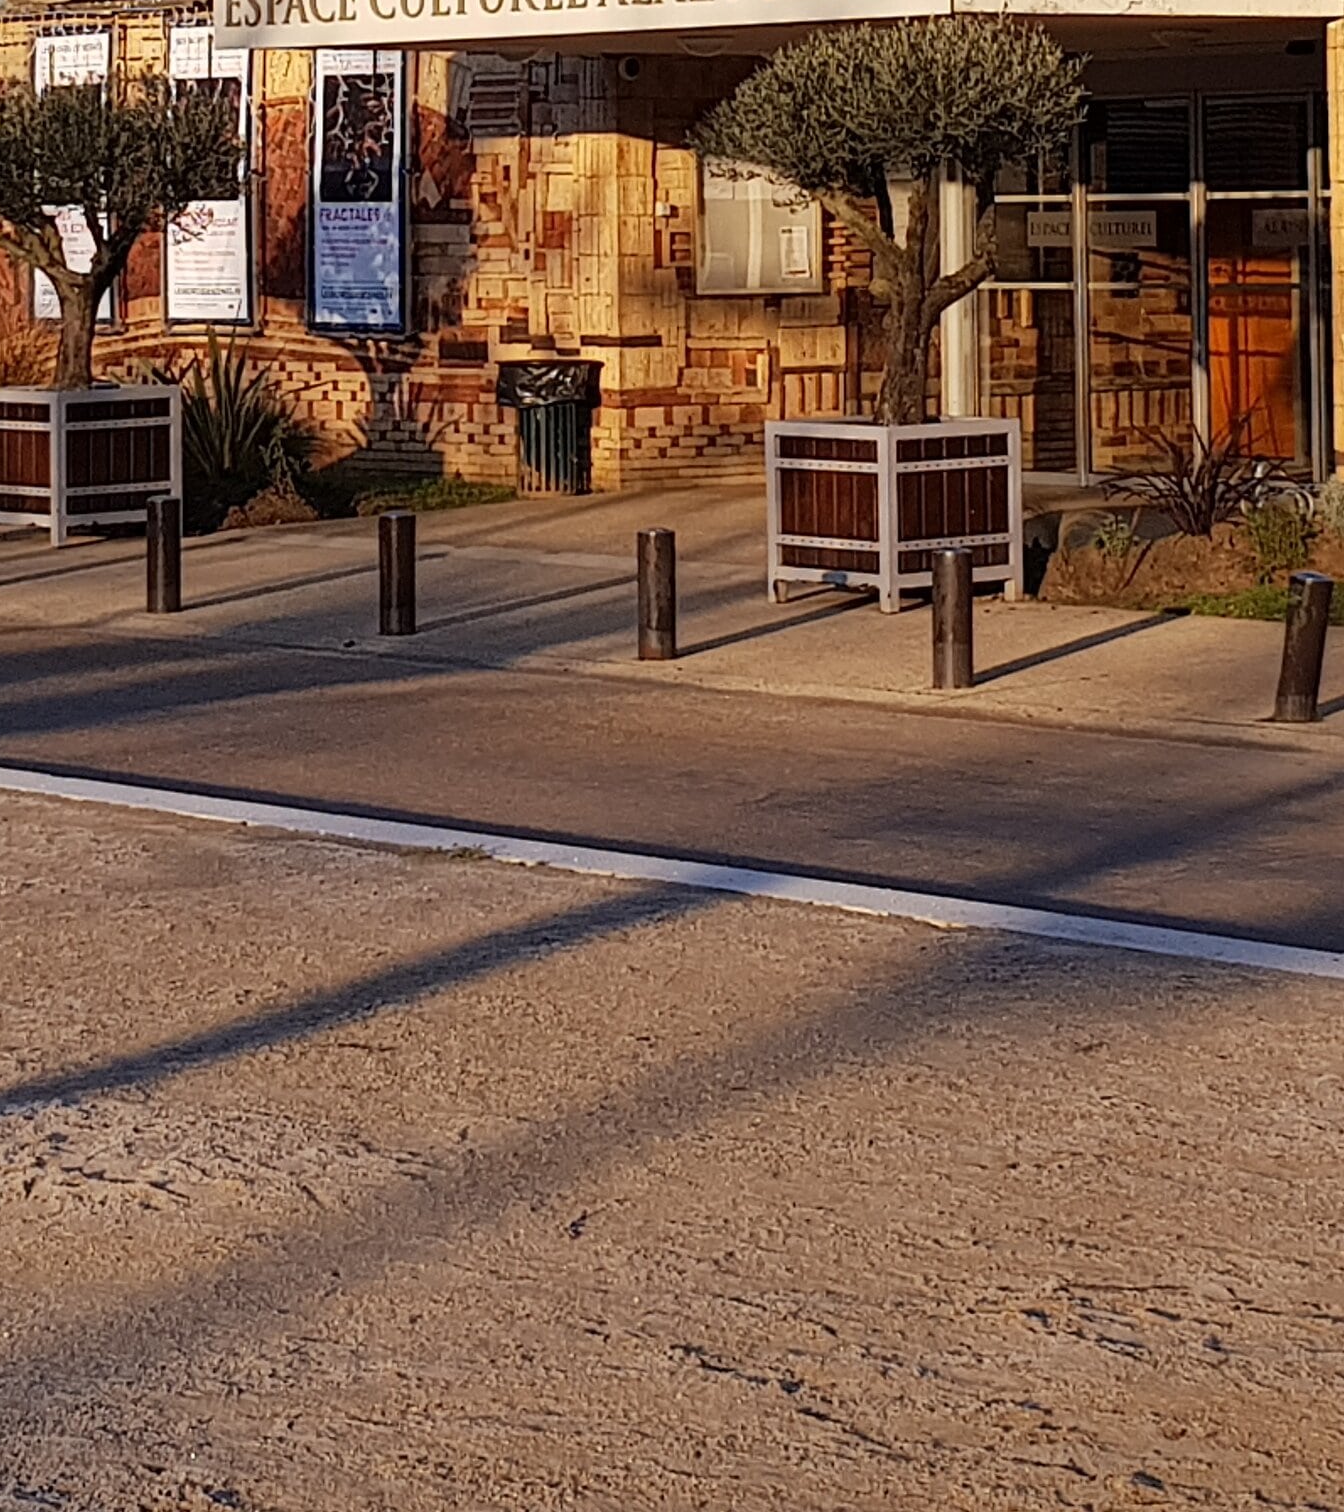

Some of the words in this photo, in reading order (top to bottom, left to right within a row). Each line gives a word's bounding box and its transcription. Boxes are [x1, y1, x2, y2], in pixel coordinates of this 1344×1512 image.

[320, 208, 381, 221] FRACTALES
[1030, 222, 1070, 236] ESPACE
[1090, 222, 1152, 236] CULTUREL
